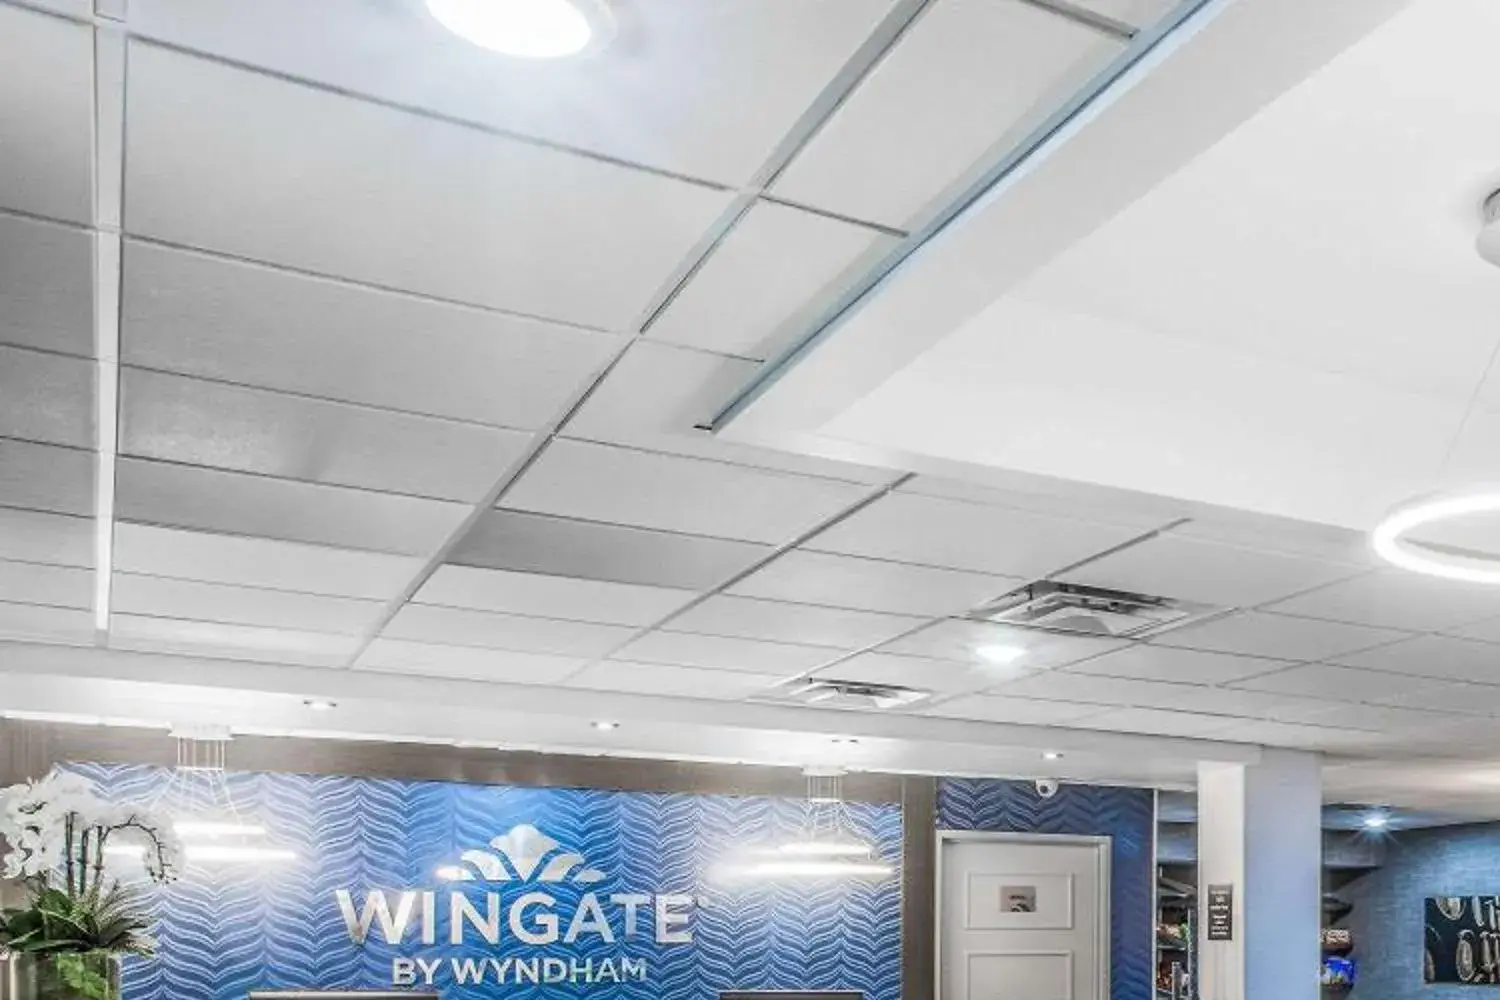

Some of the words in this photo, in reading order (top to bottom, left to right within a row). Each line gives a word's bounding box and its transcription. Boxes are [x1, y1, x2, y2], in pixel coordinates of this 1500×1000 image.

[336, 889, 694, 945] WINGATE
[392, 957, 444, 985] BY
[451, 957, 647, 984] WYNDHAM
